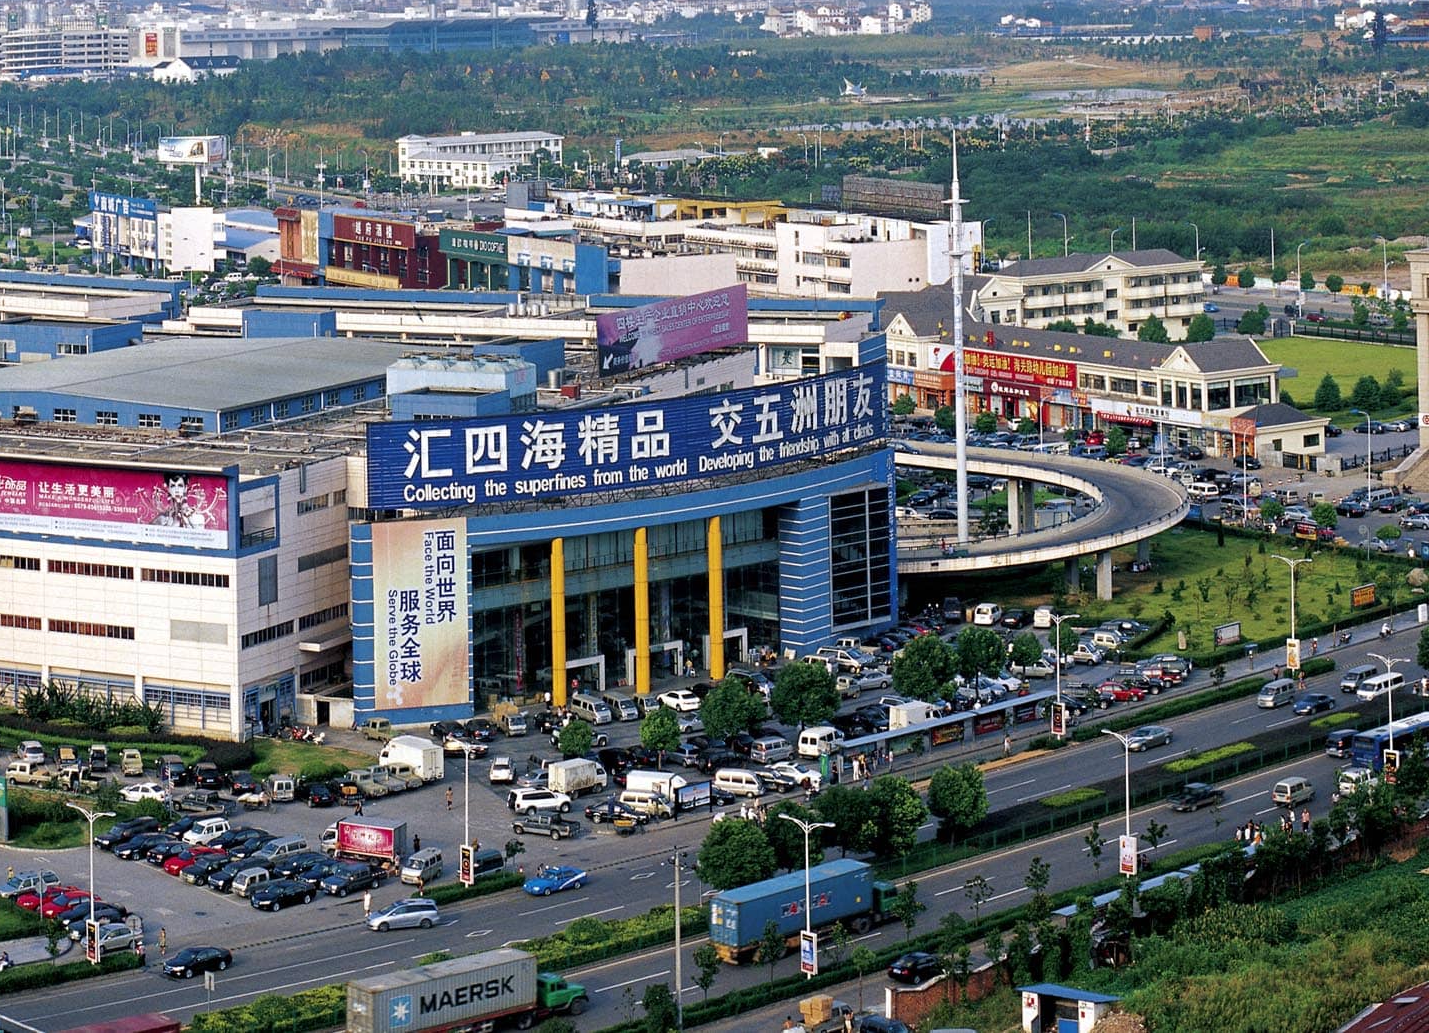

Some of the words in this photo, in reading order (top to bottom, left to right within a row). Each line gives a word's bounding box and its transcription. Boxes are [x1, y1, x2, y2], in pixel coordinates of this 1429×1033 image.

[403, 410, 670, 480] 汇四海精品
[708, 372, 875, 450] 交五洲朋友
[403, 484, 476, 503] Collecting
[484, 479, 507, 497] the
[514, 470, 587, 496] superfines
[593, 466, 624, 486] from
[629, 464, 649, 481] the
[654, 459, 687, 479] world
[698, 450, 754, 472] Developing
[759, 445, 775, 461] the
[779, 435, 820, 459] friendship
[823, 429, 840, 448] with
[841, 427, 853, 443] all
[853, 423, 875, 441] clients
[38, 481, 115, 498] 让生活更美丽
[424, 531, 434, 561] Face
[424, 564, 434, 585] the
[434, 529, 457, 623] 面向世界
[388, 589, 398, 624] Serve
[425, 588, 436, 625] World
[388, 626, 397, 647] the
[399, 589, 422, 683] 服务全球
[388, 649, 399, 686] Globe
[420, 975, 515, 1015] MAERSK
